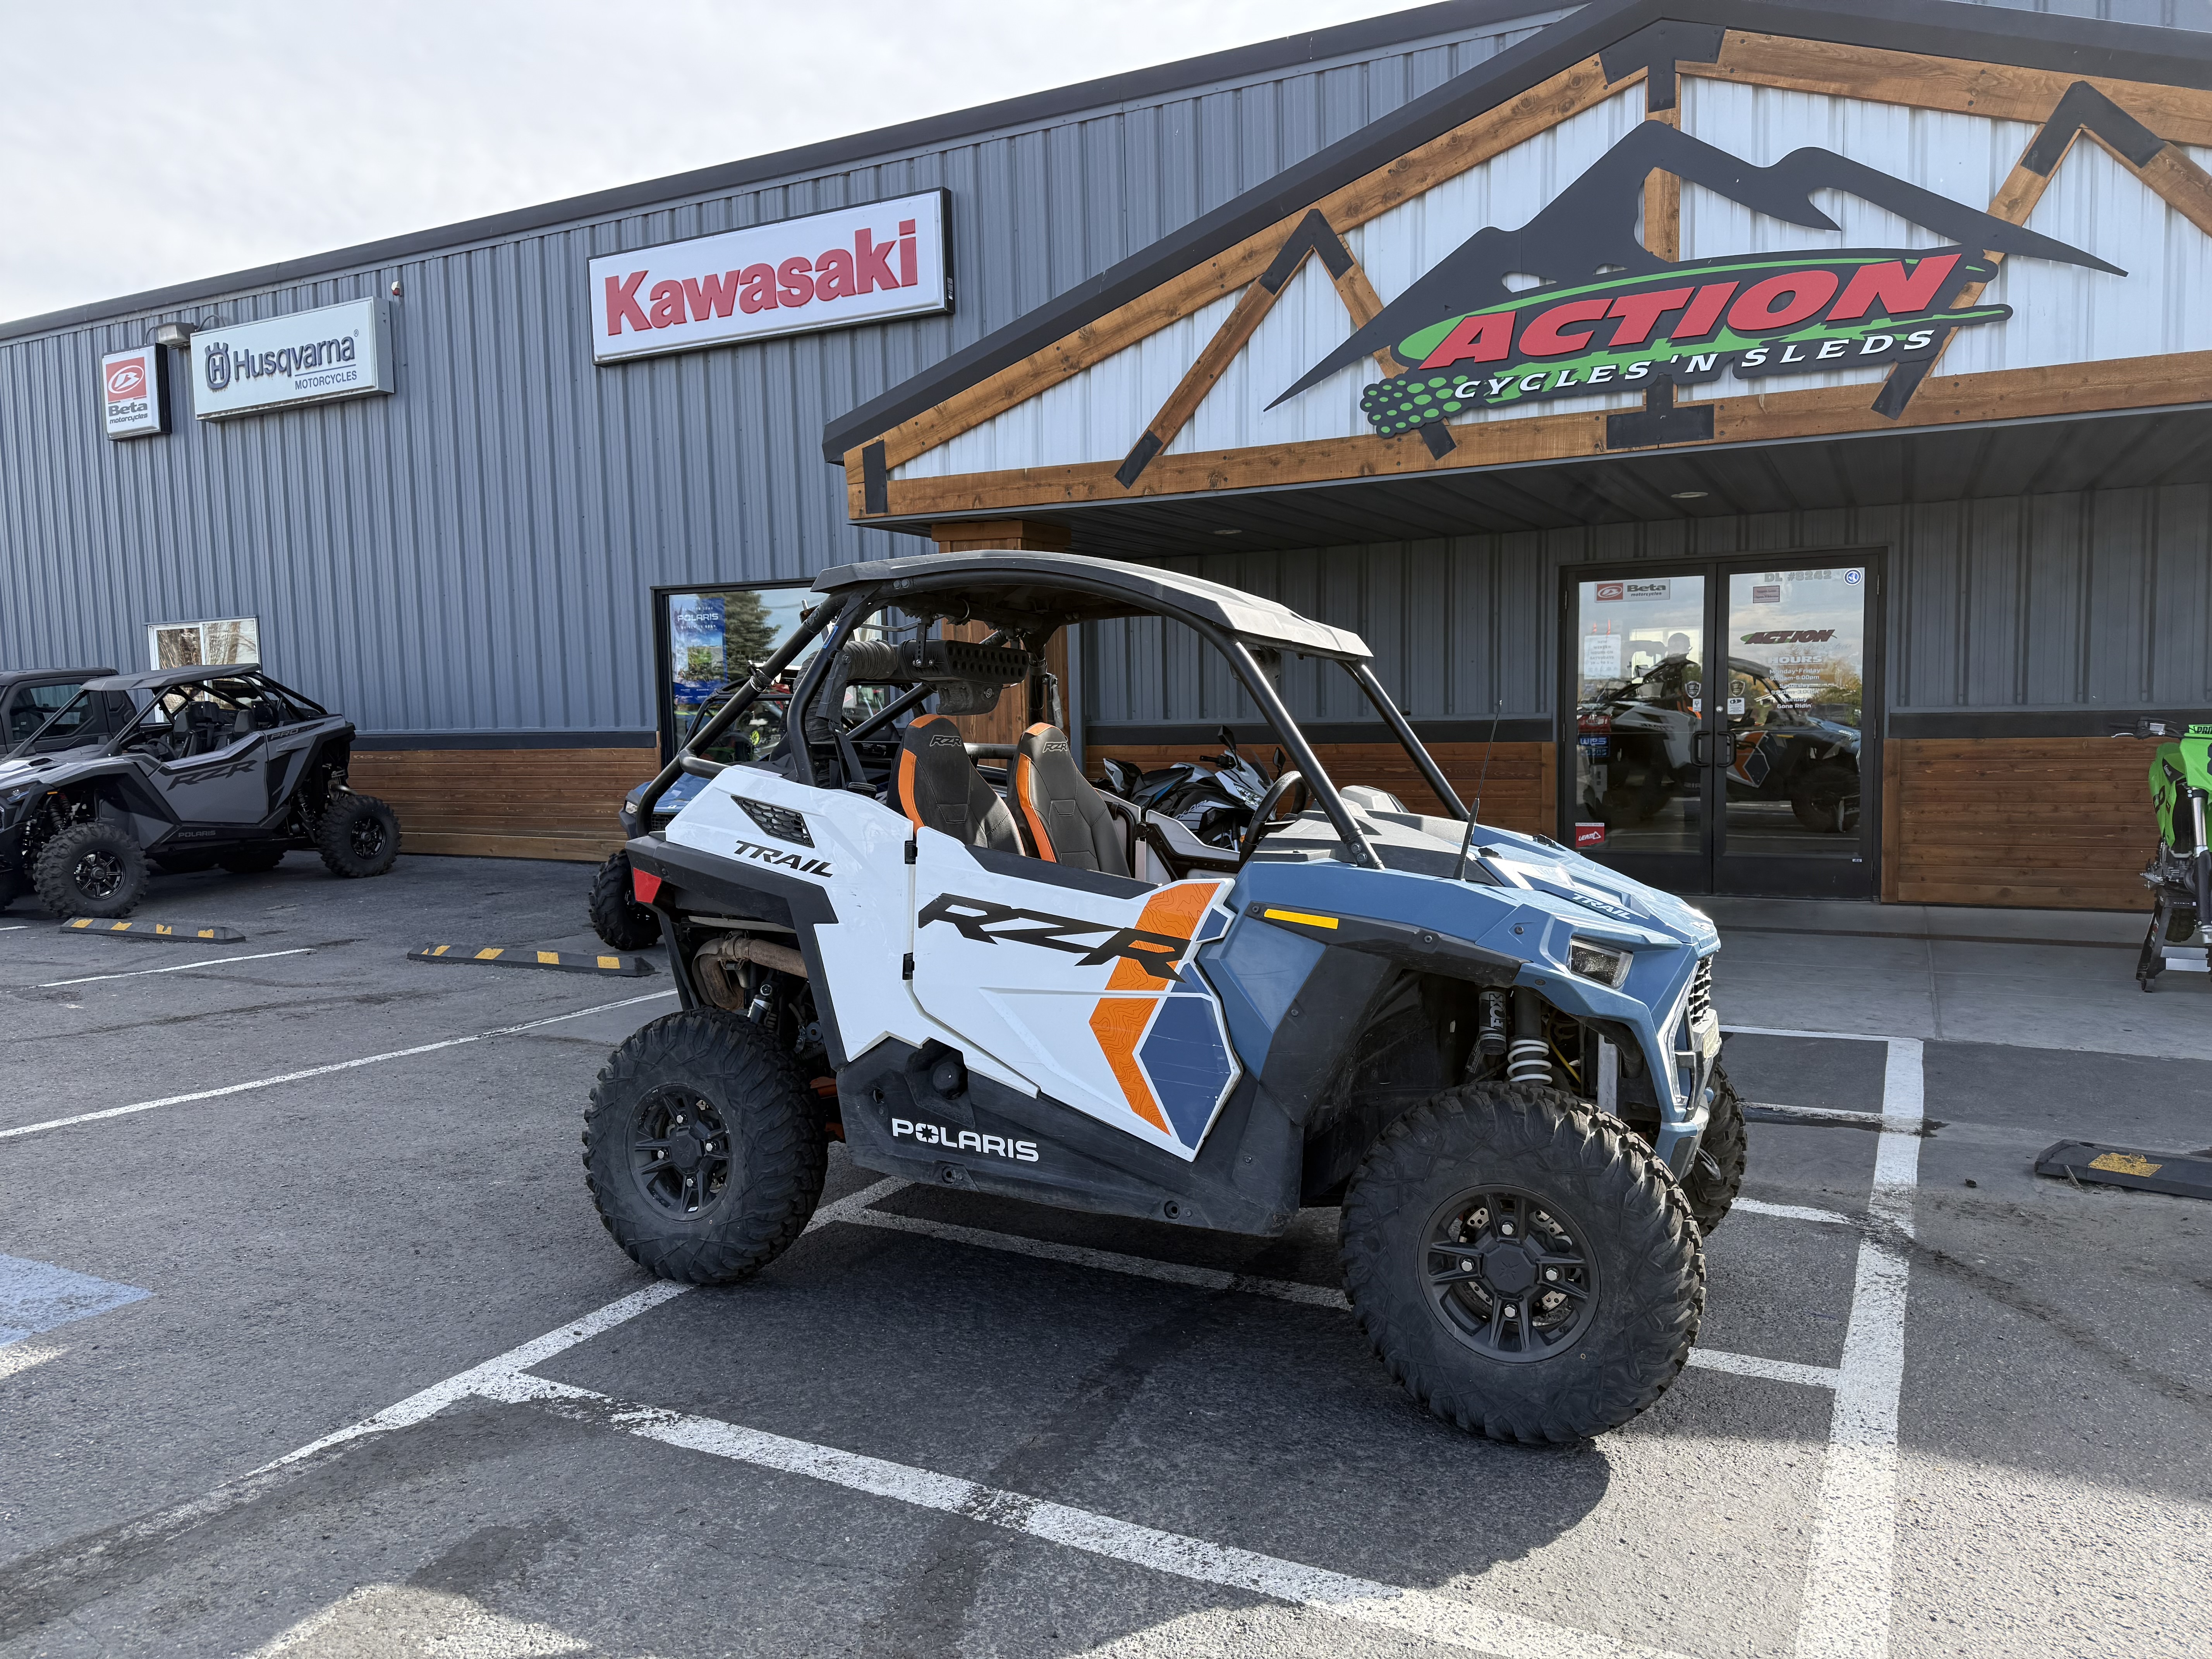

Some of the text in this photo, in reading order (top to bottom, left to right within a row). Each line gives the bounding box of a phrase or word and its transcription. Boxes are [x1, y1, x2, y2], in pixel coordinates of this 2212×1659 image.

[605, 218, 918, 337] Kawasaki
[1419, 253, 1962, 370] ACTION
[233, 336, 355, 381] Husqvarna
[1455, 361, 1652, 399] CYCLES
[1741, 329, 1936, 368] SLEDS
[295, 370, 357, 390] MOTORCYCLES
[108, 402, 148, 417] Beta
[110, 413, 148, 425] motorcycles
[1764, 570, 1832, 582] DL #8242
[1627, 584, 1666, 592] Beta
[677, 613, 719, 622] POLARIS
[1744, 629, 1835, 644] ACTION
[1768, 655, 1822, 664] HOURS
[271, 728, 299, 740] PRO
[929, 734, 962, 747] RZR
[1042, 741, 1068, 753] RZR
[166, 759, 258, 792] RZR
[734, 840, 833, 878] TRAIL
[1572, 893, 1631, 920] TRAIL
[918, 893, 1191, 983] RZR
[1489, 993, 1506, 1029] FOX
[892, 1118, 1039, 1162] POLARIS
